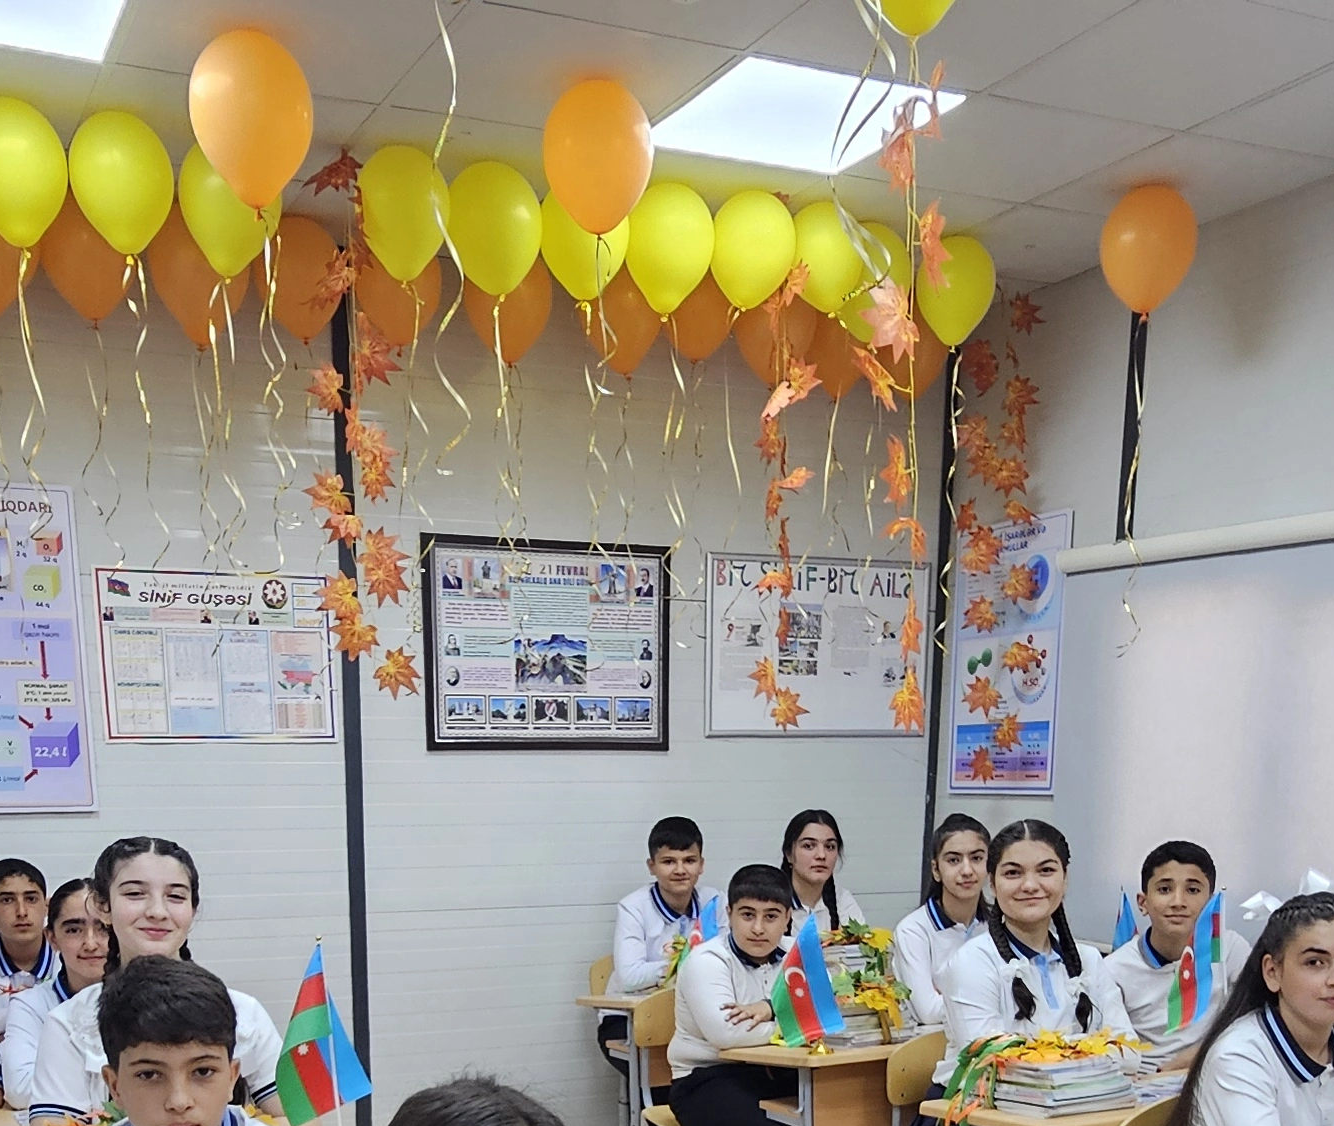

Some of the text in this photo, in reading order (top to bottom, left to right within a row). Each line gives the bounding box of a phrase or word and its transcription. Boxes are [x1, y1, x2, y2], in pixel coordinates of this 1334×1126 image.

[539, 563, 552, 575] 21
[138, 589, 182, 604] SİNİF
[34, 746, 59, 758] 22,4
